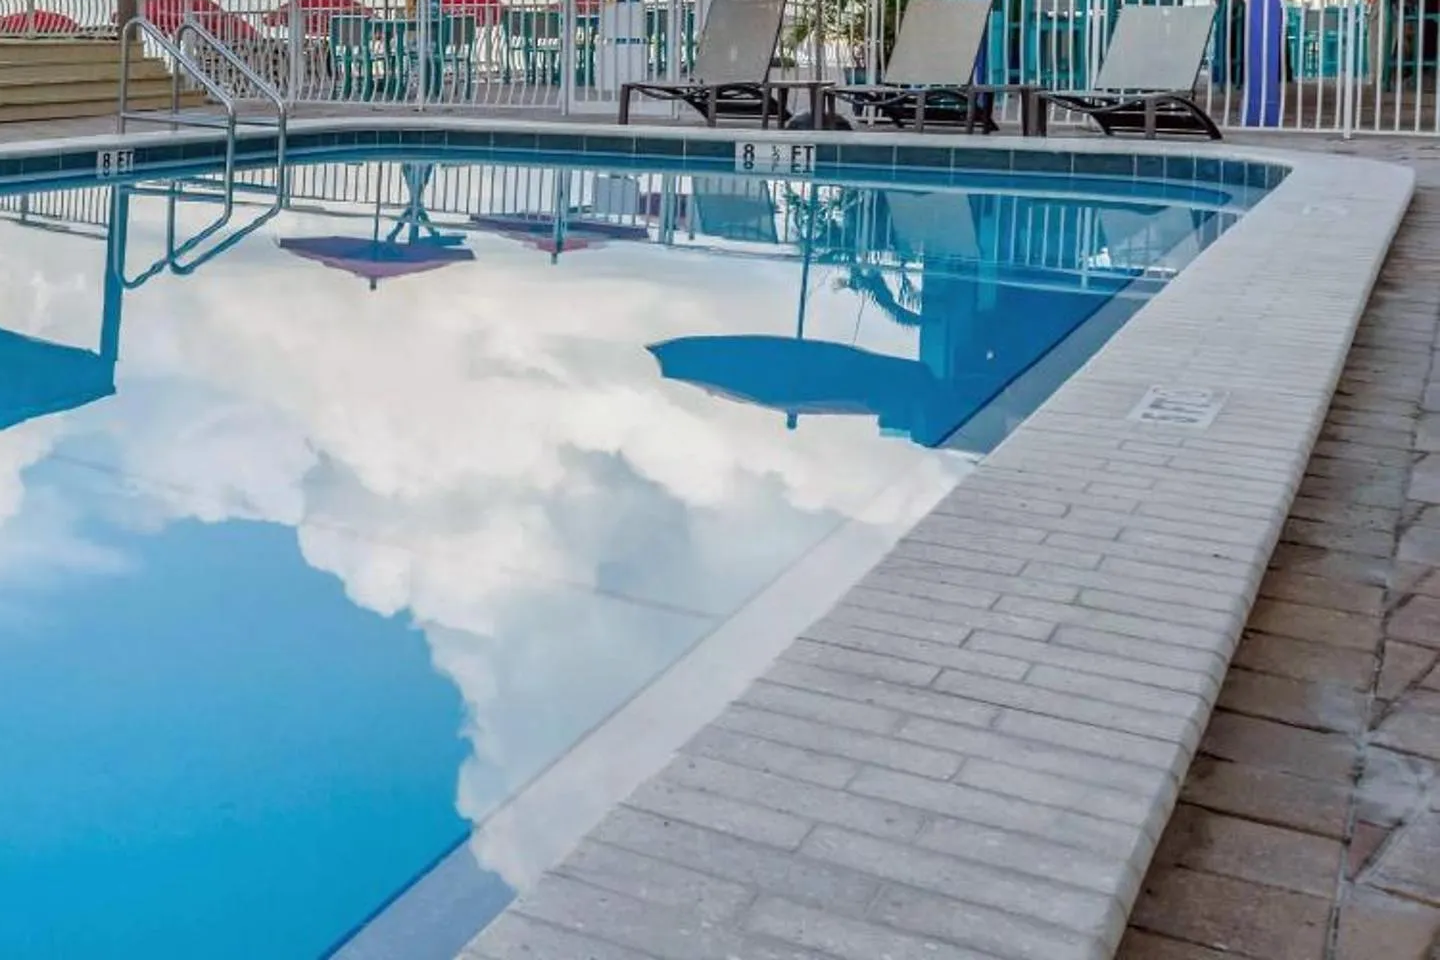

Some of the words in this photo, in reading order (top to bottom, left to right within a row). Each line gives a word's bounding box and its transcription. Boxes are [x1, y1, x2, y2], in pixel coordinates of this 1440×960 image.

[103, 152, 111, 169] 8
[743, 143, 755, 162] 8
[791, 145, 814, 163] FT
